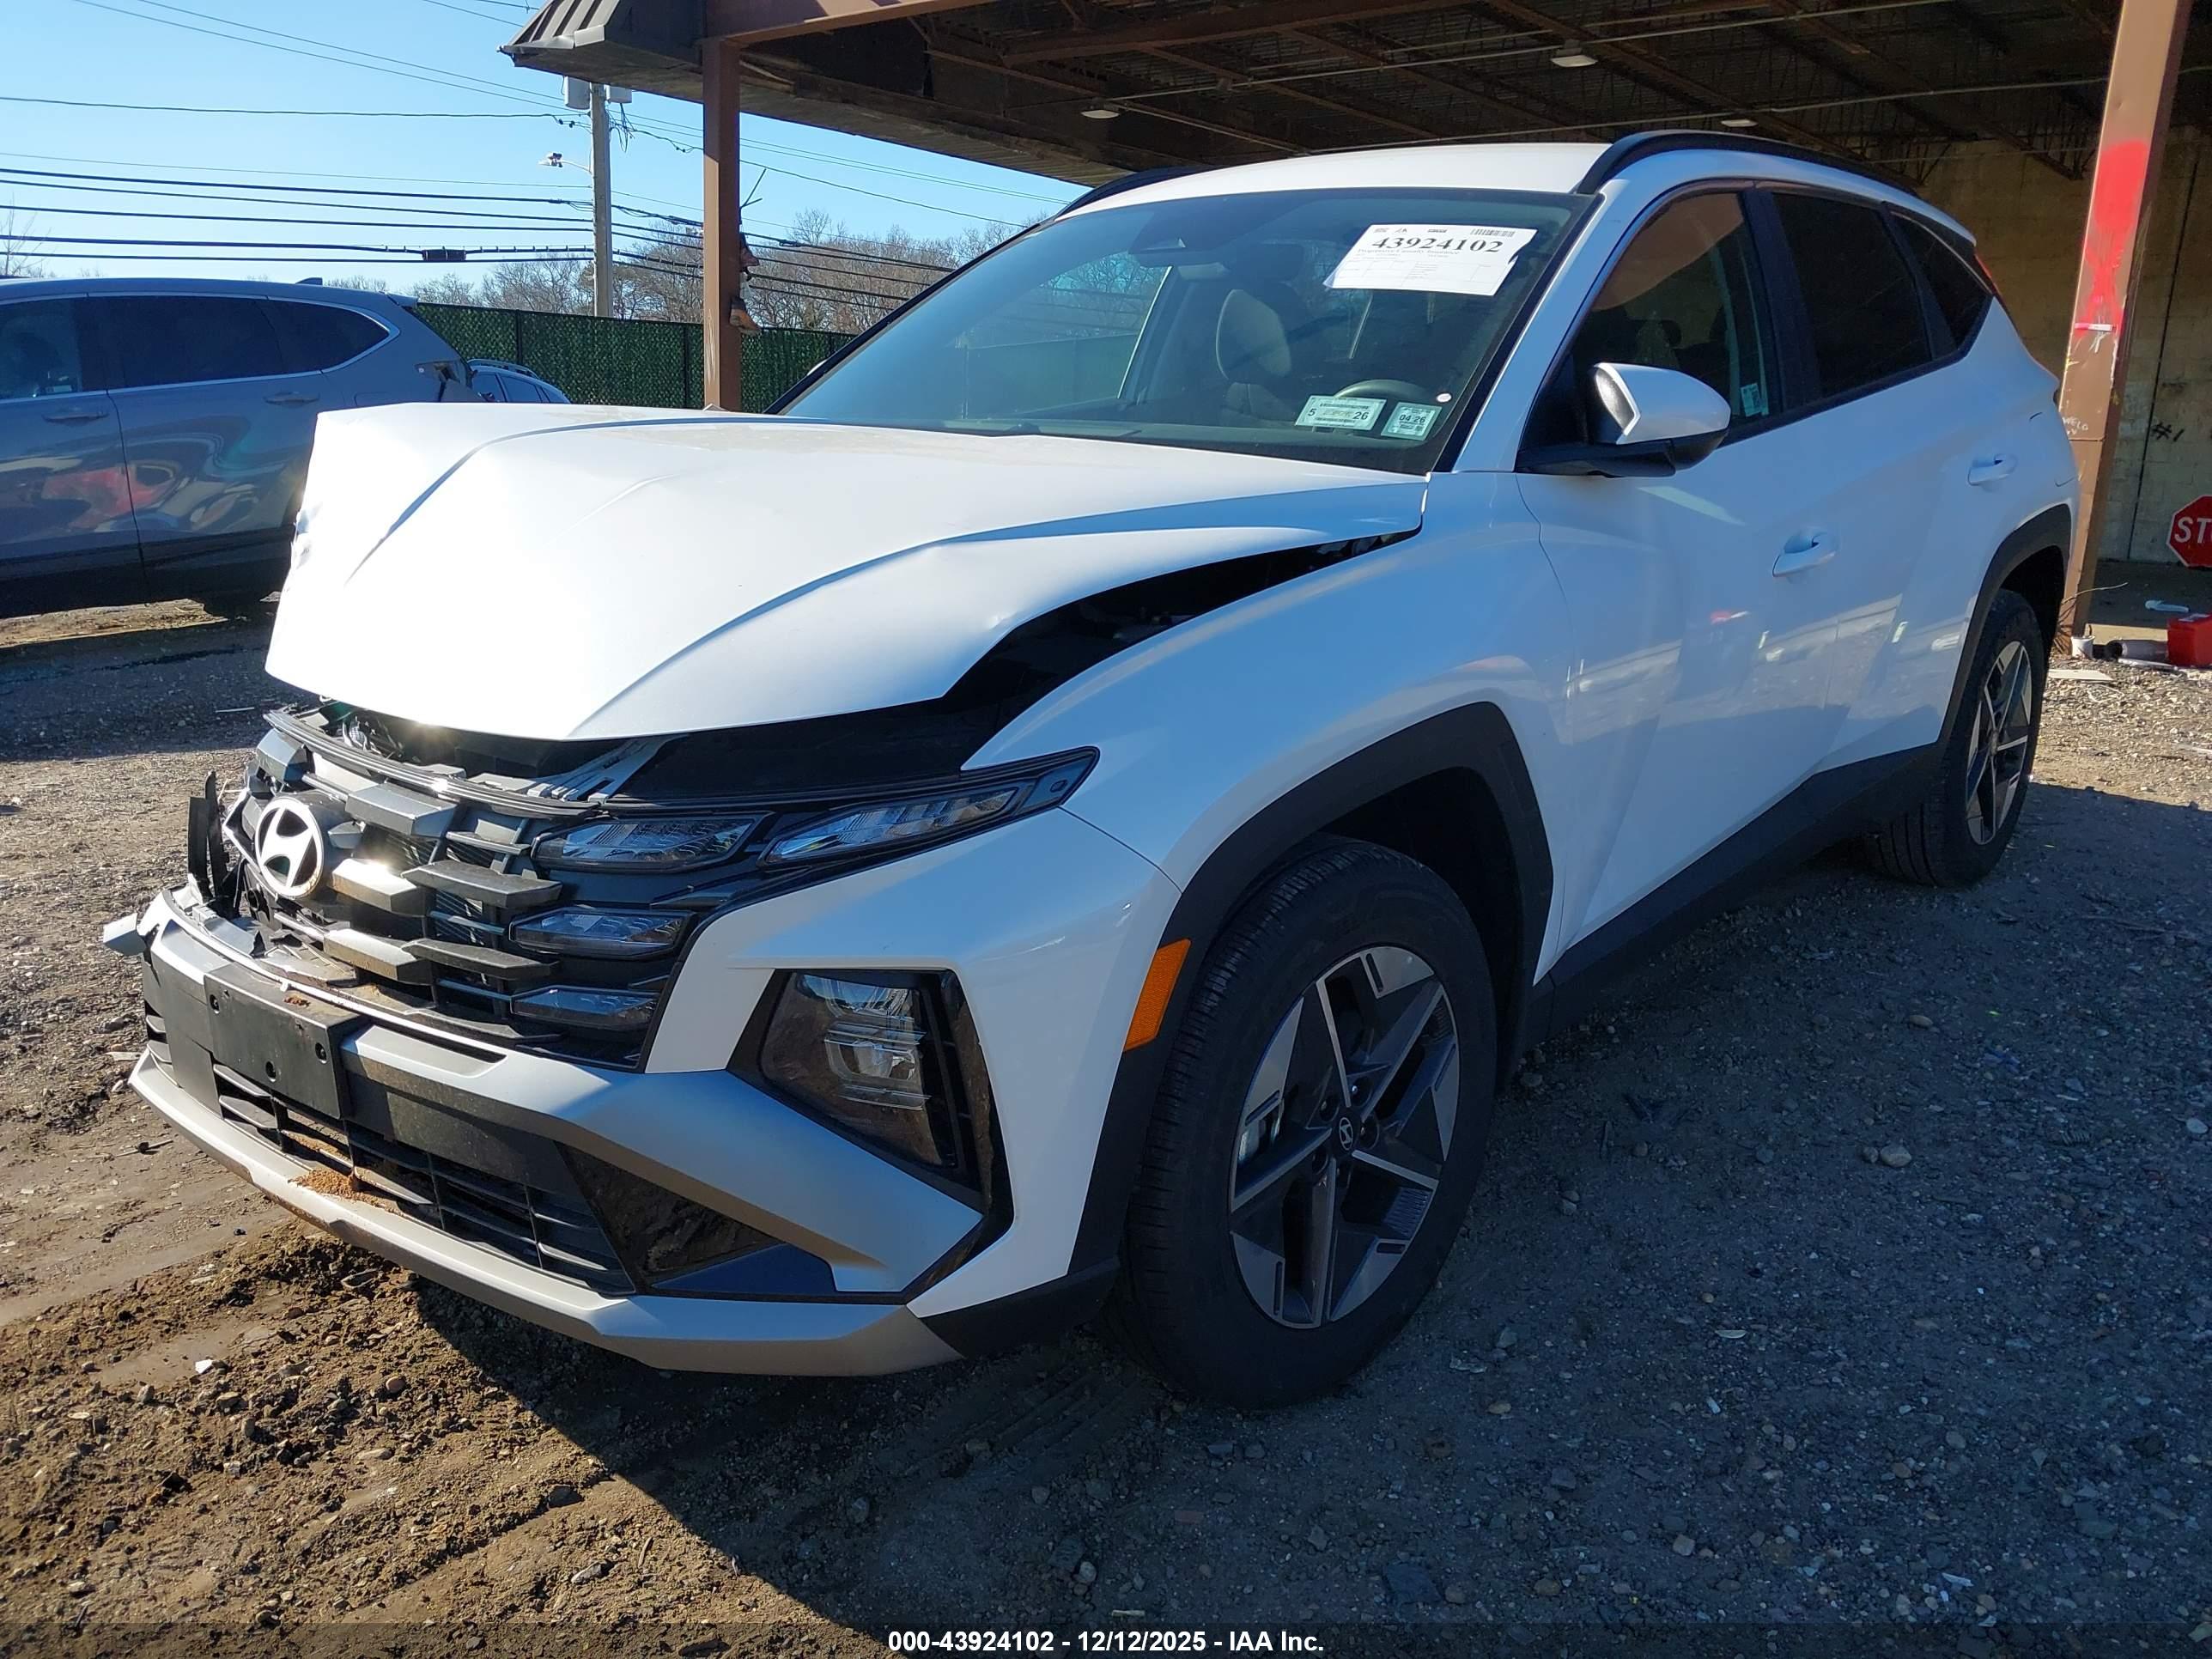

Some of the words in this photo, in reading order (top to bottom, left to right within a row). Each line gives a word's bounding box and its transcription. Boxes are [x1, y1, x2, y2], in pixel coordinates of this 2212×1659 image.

[1371, 236, 1504, 252] 43924102
[1308, 408, 1317, 416] 5
[1352, 411, 1369, 421] 26
[2174, 516, 2212, 544] ST
